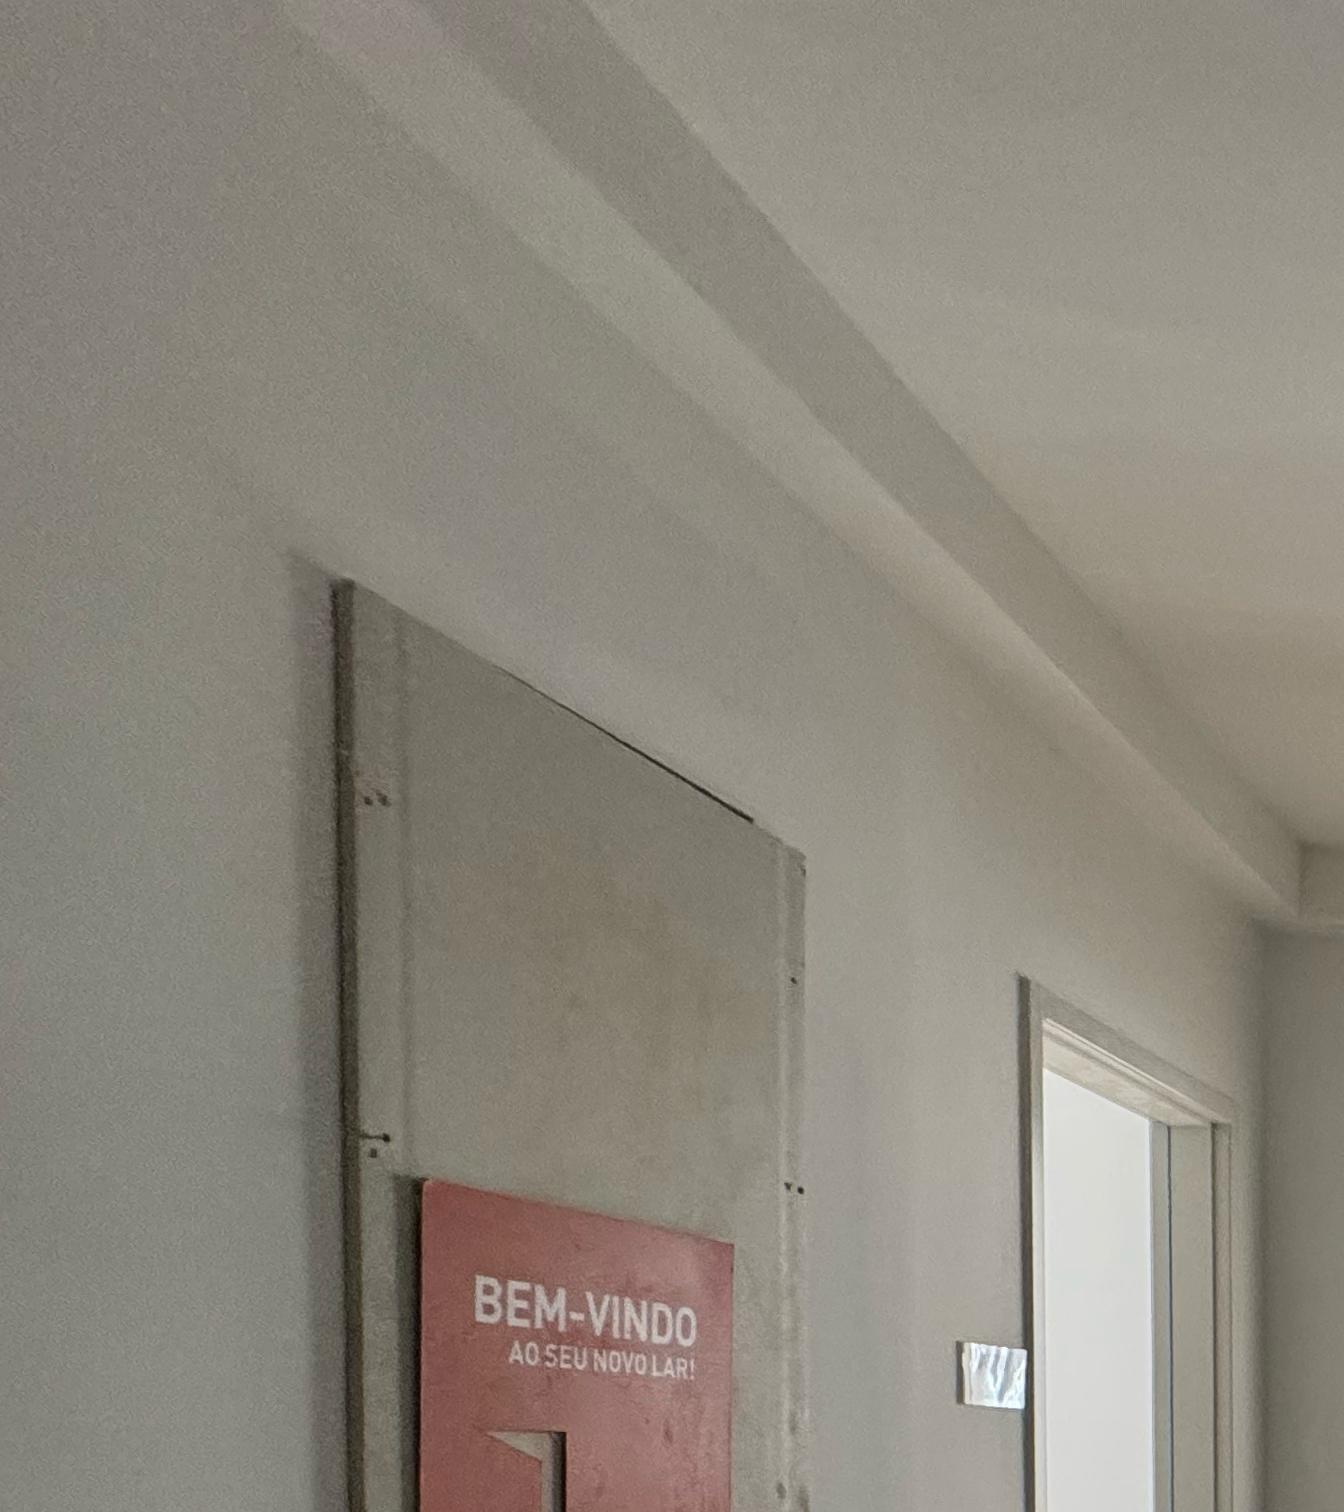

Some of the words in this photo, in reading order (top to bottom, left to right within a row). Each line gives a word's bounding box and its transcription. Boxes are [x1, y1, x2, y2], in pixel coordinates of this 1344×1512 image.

[474, 1274, 697, 1347] BEM-VINDO
[508, 1340, 540, 1367] AO
[544, 1344, 588, 1371] SEU
[593, 1349, 647, 1375] NOVO
[651, 1354, 695, 1380] LAR!
